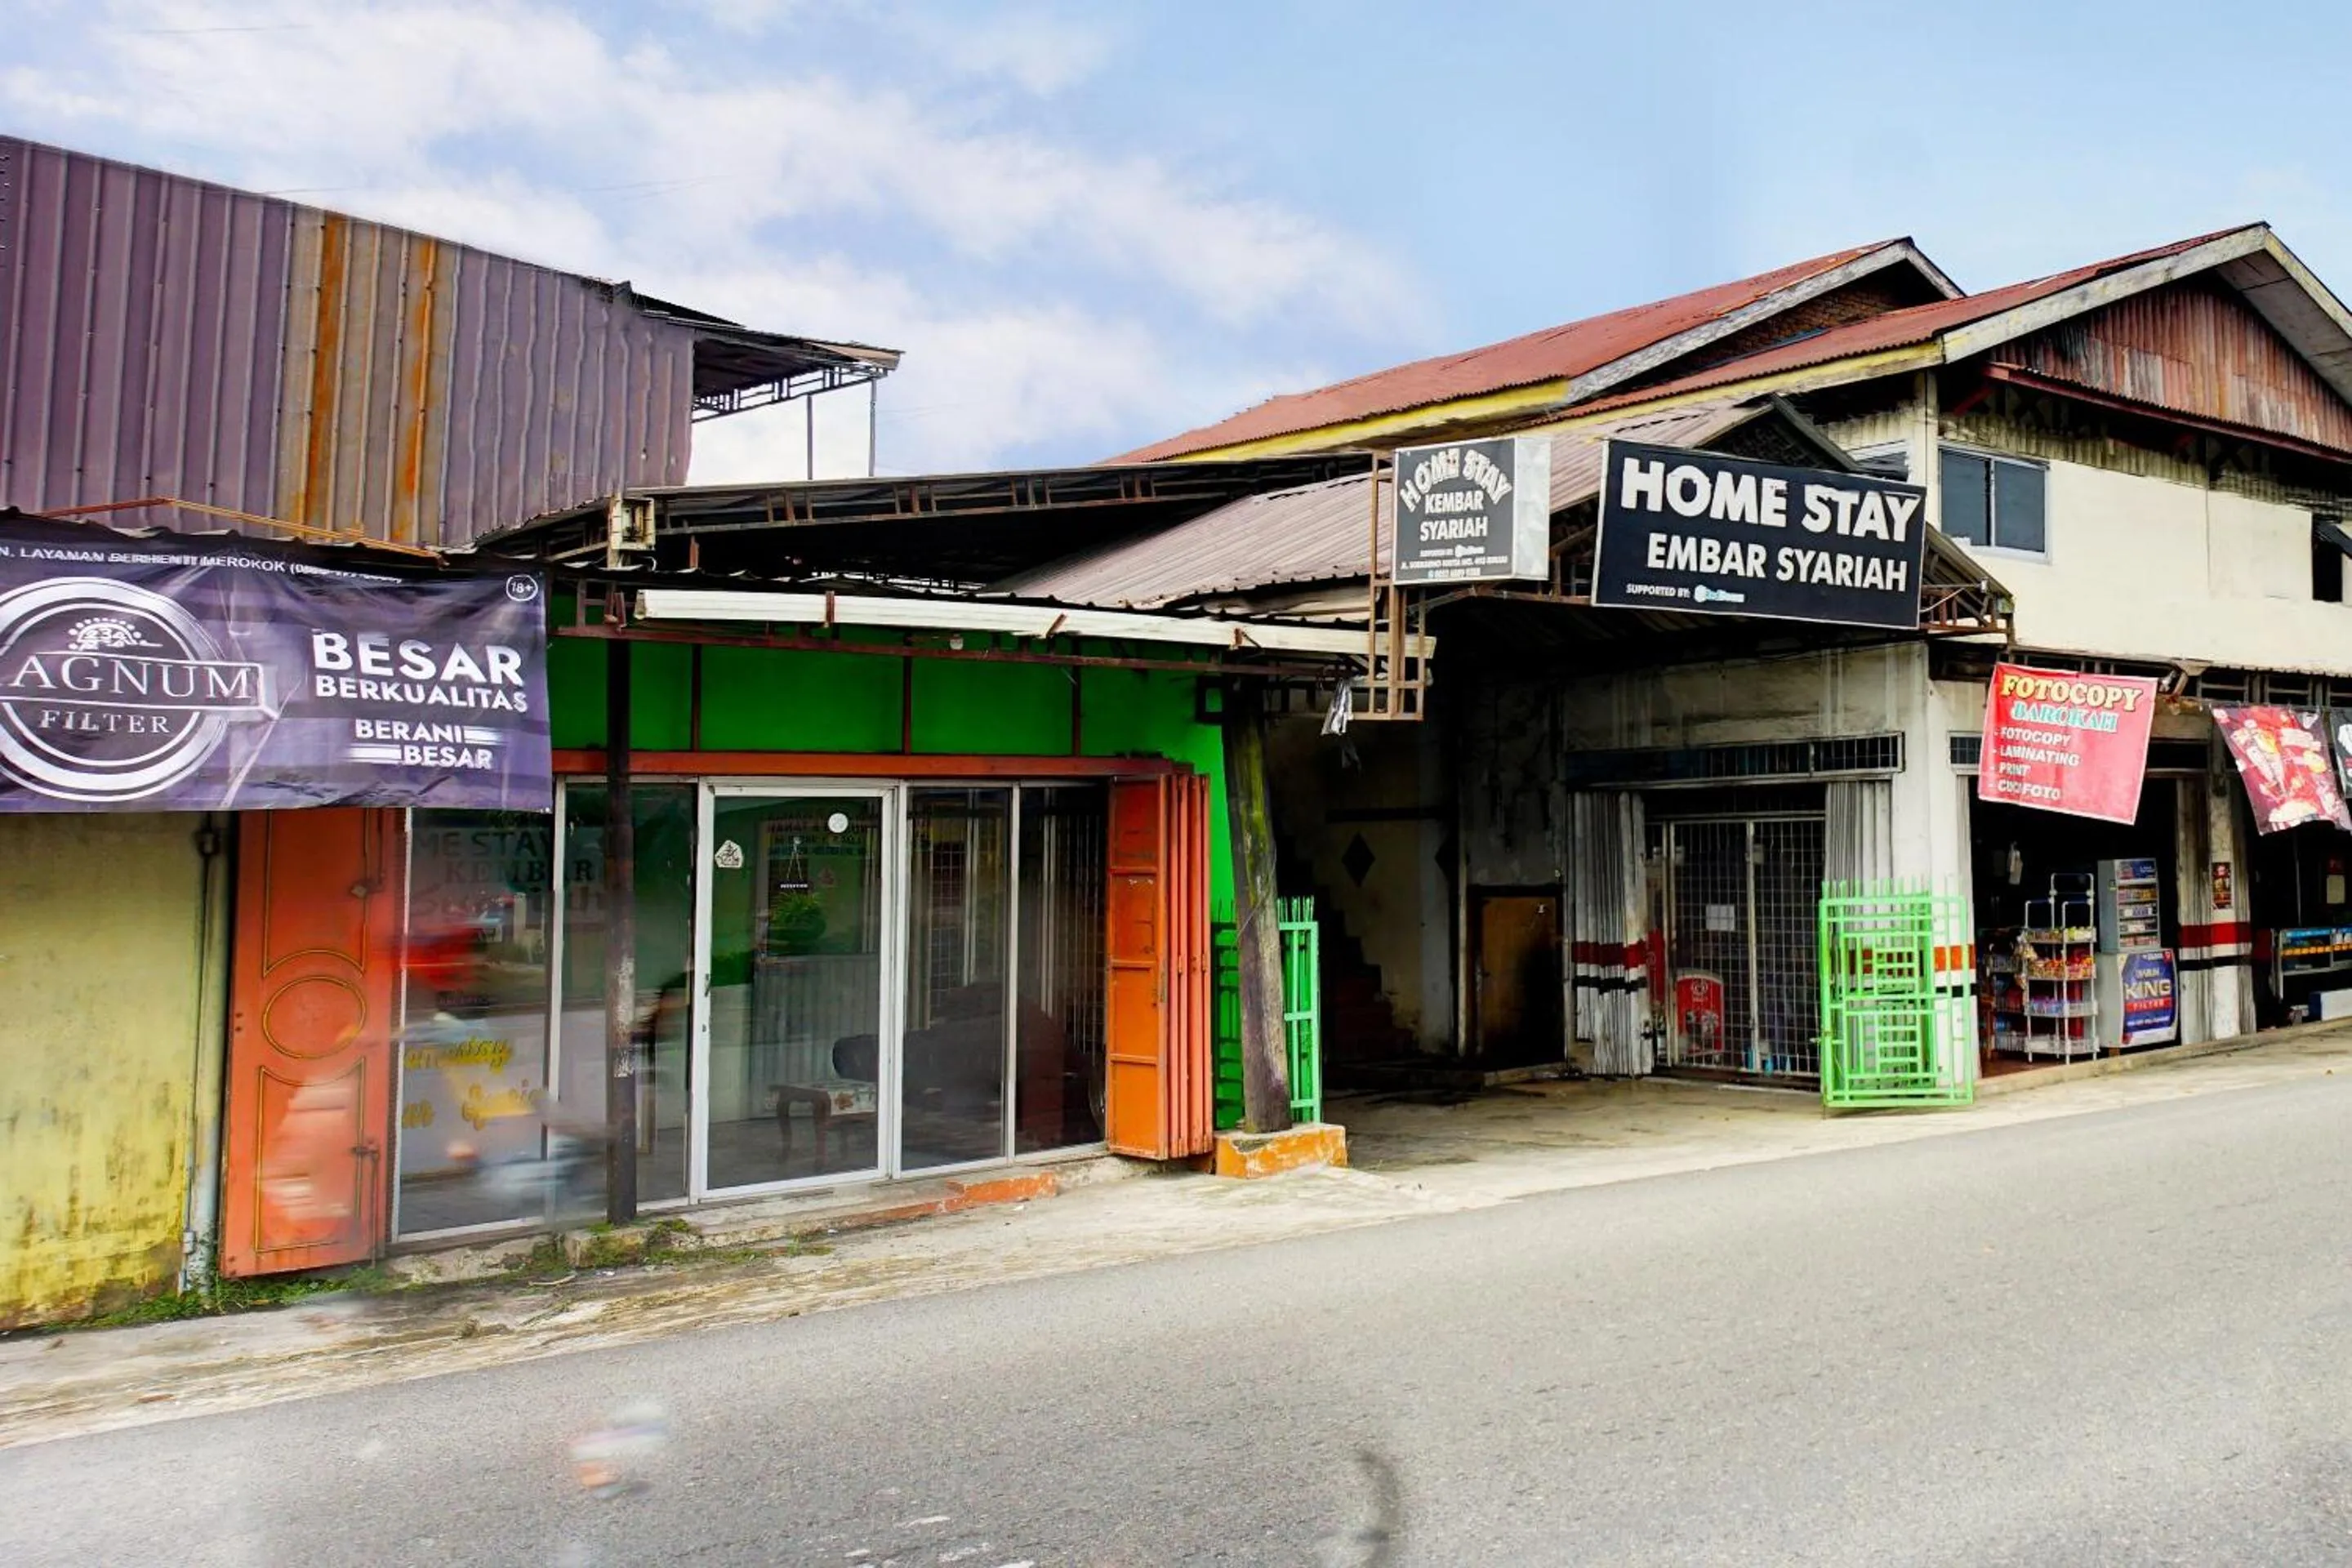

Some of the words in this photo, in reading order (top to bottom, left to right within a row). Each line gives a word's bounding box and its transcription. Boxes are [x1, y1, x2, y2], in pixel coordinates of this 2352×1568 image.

[1400, 448, 1459, 512] HOME
[1462, 449, 1512, 505] STAY
[1425, 490, 1484, 514] KEMBAR
[1621, 457, 1788, 528] HOME
[1802, 483, 1922, 542] STAY
[1420, 516, 1488, 541] SYARIAH
[1646, 532, 1766, 577] EMBAR
[1776, 546, 1908, 592] SYARIAH
[510, 581, 534, 594] 18+
[1626, 583, 1676, 597] SUPPORTED
[313, 631, 524, 687] BESAR
[0, 655, 252, 699] AGNUM
[315, 675, 528, 713] BERKUALITAS
[2001, 673, 2143, 712] FOTOCOPY
[41, 710, 171, 733] FILTER
[2011, 700, 2119, 733] BAROKAH
[355, 719, 463, 743] BERANI
[2002, 727, 2071, 746] FOTOCOPY
[401, 745, 493, 769] BESAR
[2000, 745, 2081, 766] LAMINATING
[1998, 762, 2031, 777] PRINT
[2021, 783, 2060, 800] FOTO
[2124, 979, 2171, 1000] KING
